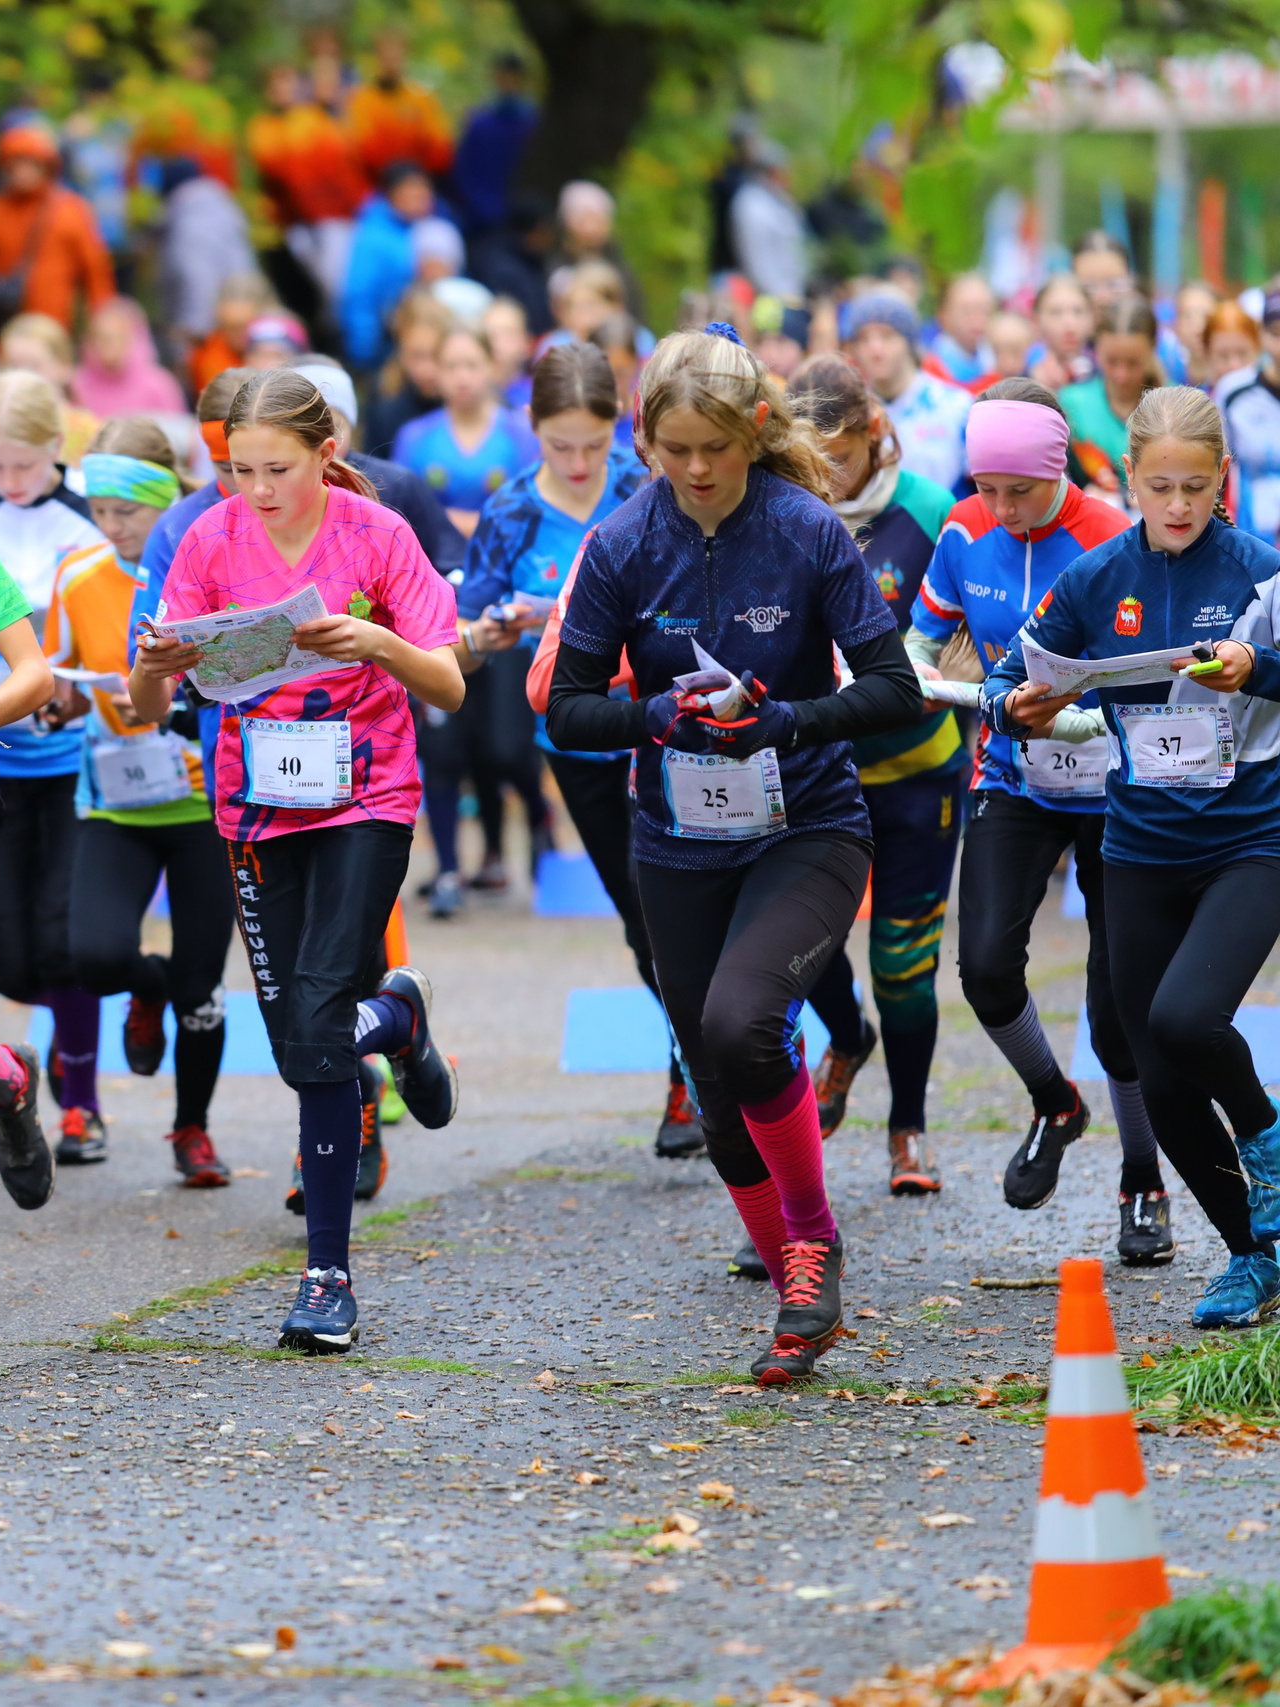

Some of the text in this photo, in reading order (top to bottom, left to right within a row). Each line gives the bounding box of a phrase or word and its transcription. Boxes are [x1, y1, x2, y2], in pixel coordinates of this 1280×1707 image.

[964, 580, 1007, 602] СШОР 18
[1200, 605, 1227, 614] МБУ ДО
[1157, 736, 1182, 756] 37
[277, 756, 302, 776] 40
[1051, 751, 1078, 770] 26
[1172, 759, 1177, 767] 2
[1178, 759, 1207, 767] линия
[289, 780, 294, 788] 2
[701, 788, 729, 808] 25
[717, 811, 722, 819] 2
[725, 811, 754, 819] линия
[236, 868, 281, 1002] НАВСЕГДА
